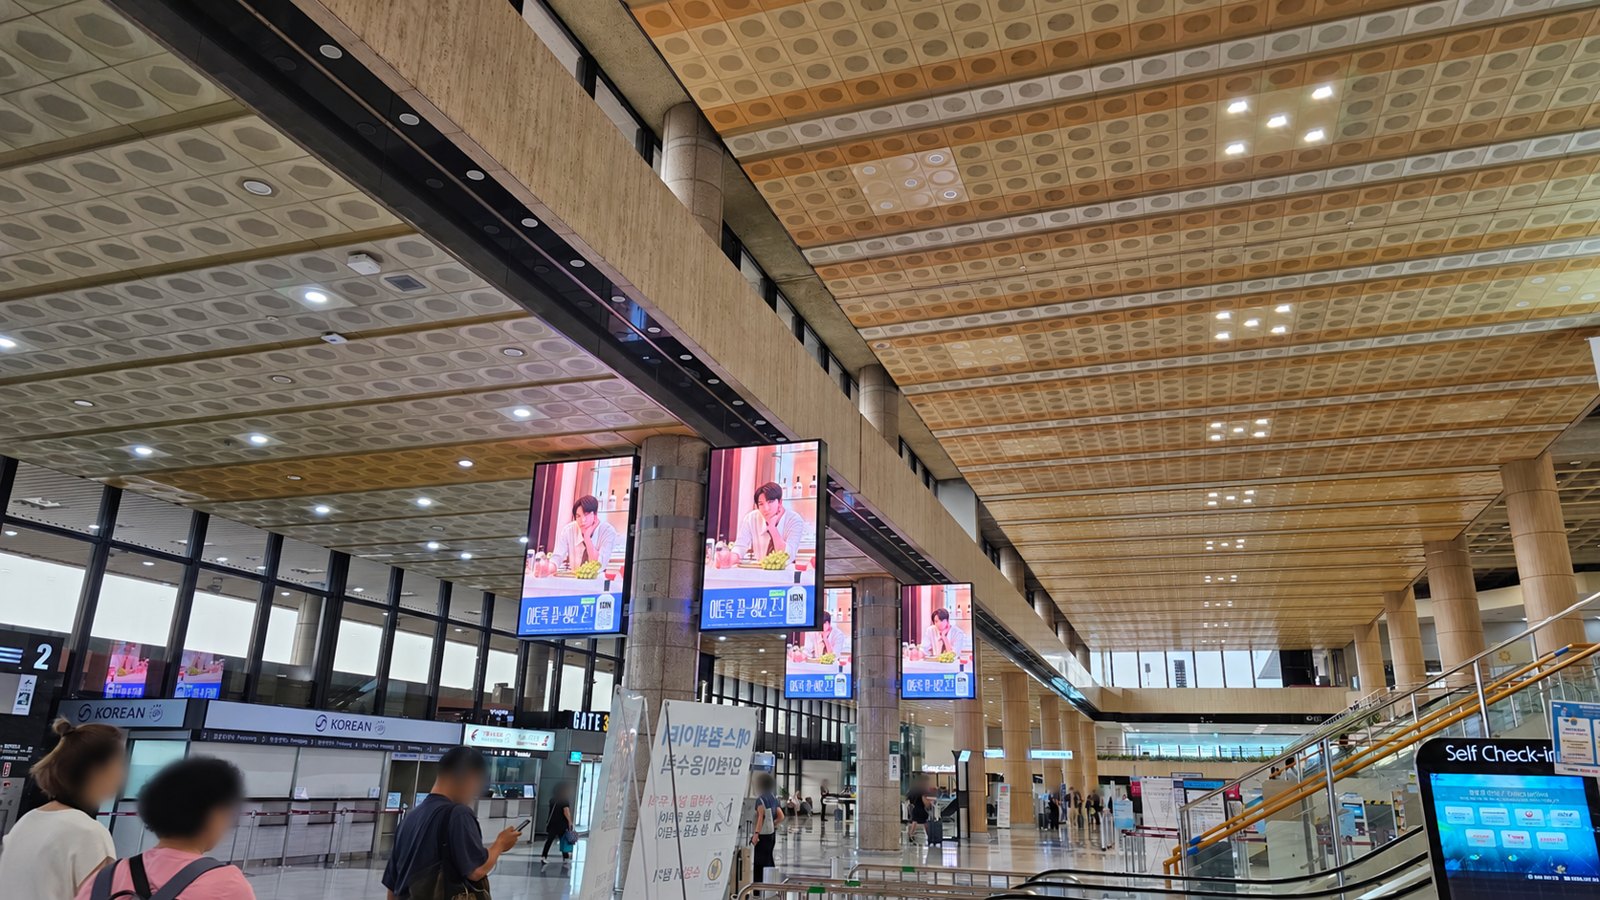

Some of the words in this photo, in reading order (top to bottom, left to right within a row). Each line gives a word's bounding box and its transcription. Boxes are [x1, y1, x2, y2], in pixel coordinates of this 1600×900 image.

[33, 643, 53, 670] 2
[95, 706, 146, 719] KOREAN
[330, 718, 372, 732] KOREAN
[573, 711, 600, 731] GATE
[603, 714, 609, 732] 3
[1445, 744, 1477, 761] Self
